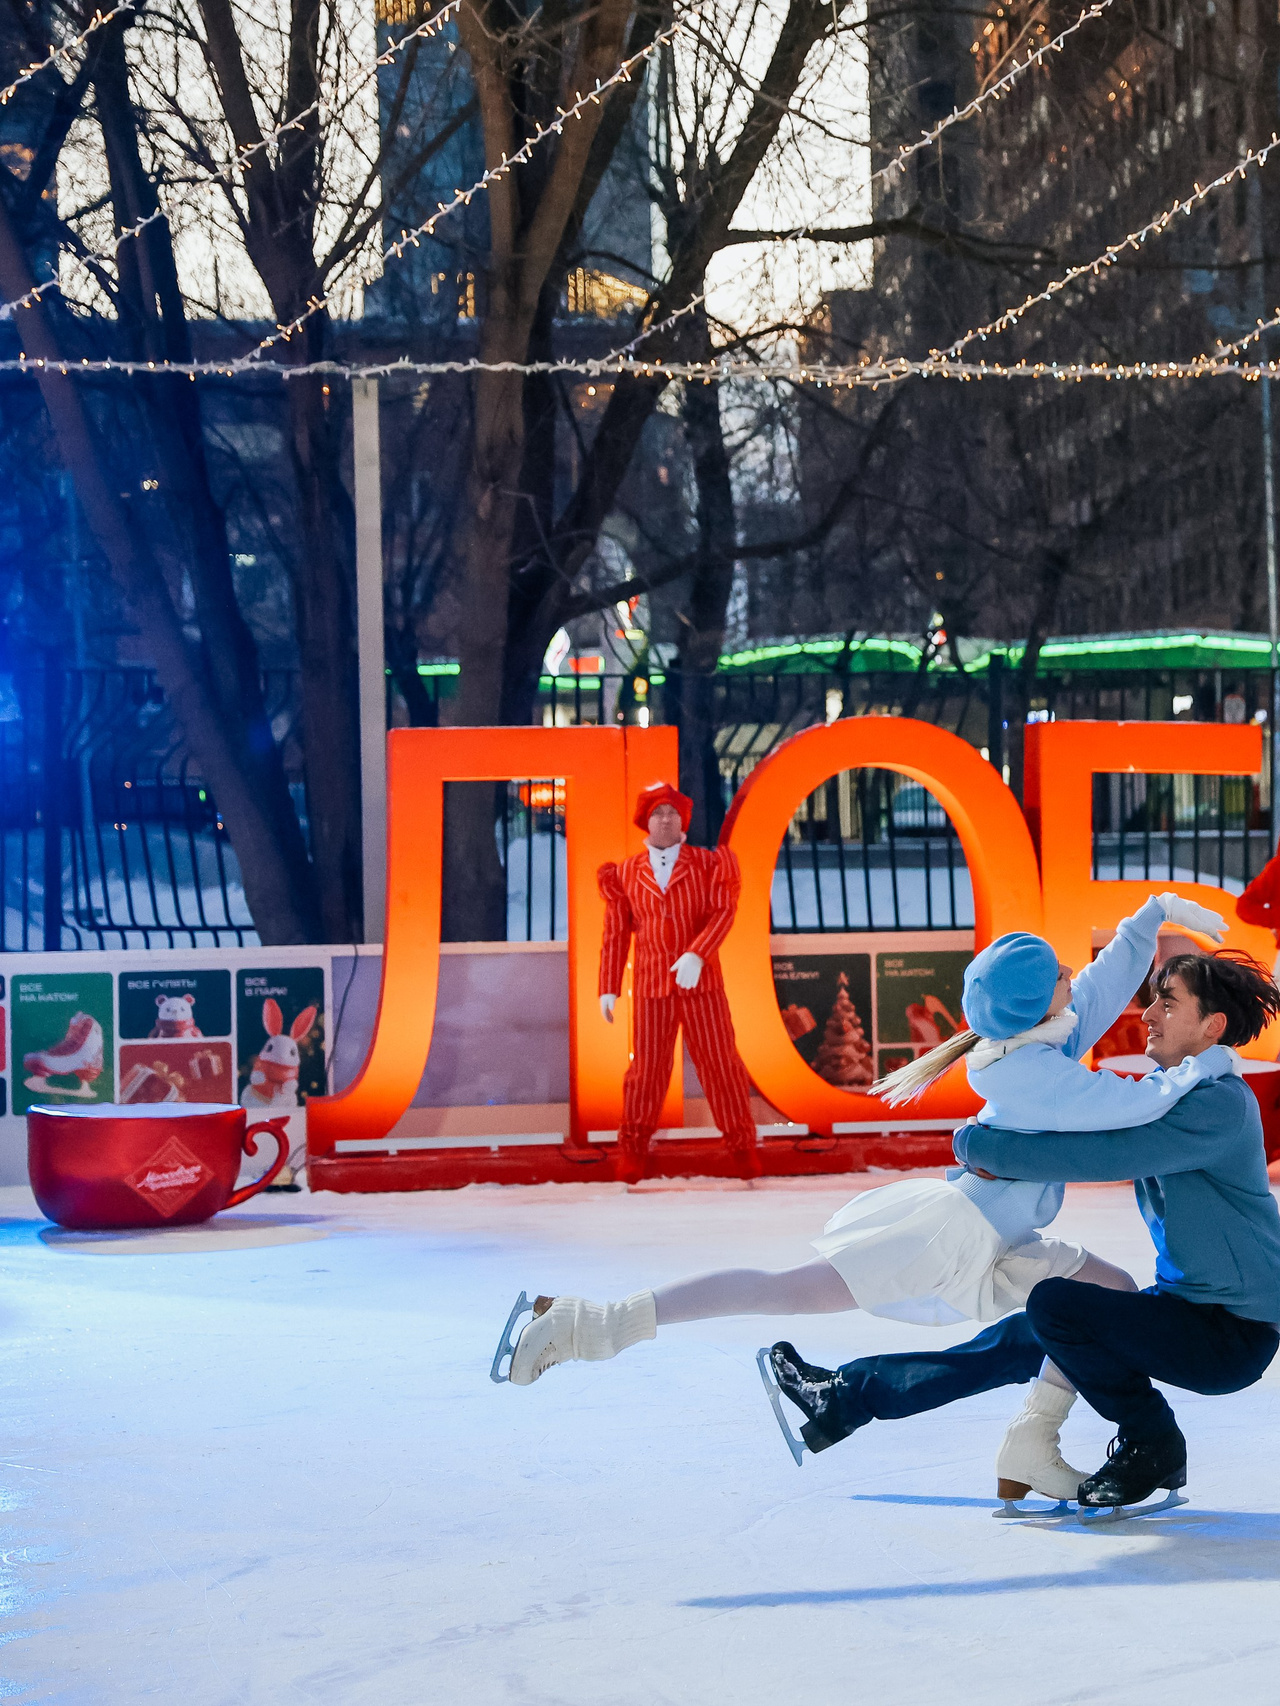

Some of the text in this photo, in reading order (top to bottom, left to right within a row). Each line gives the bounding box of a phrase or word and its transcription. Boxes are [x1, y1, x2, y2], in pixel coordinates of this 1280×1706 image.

[127, 980, 150, 990] ВСЕ
[244, 977, 267, 987] ВСЕ
[19, 982, 43, 993] ВСЕ
